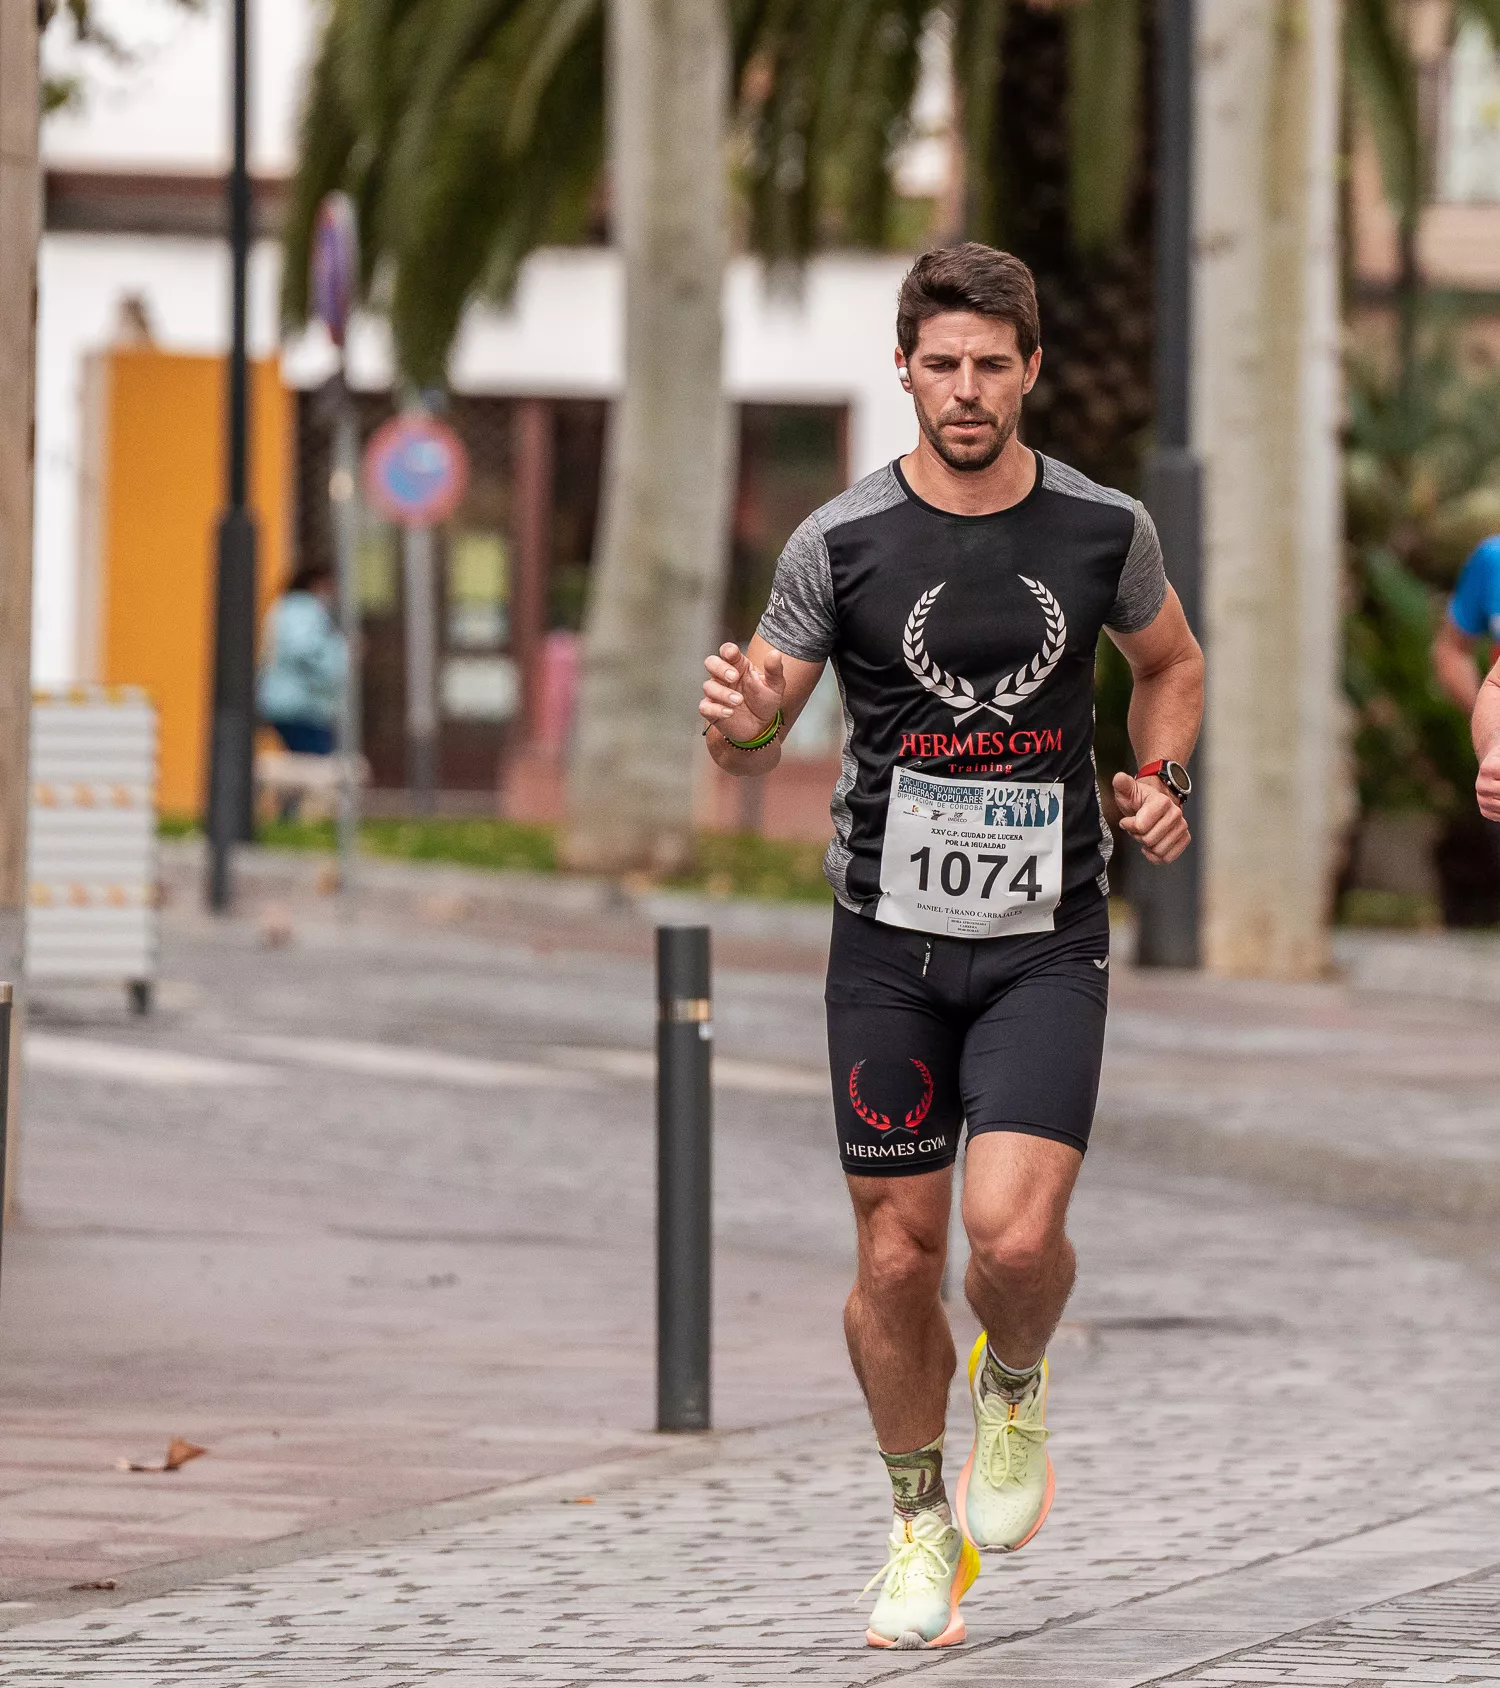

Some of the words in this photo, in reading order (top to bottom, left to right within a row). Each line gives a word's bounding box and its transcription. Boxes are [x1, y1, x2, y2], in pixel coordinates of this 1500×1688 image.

[898, 732, 1004, 756] HERMES
[1009, 728, 1062, 755] GYM
[948, 762, 1012, 774] Training
[898, 784, 935, 800] CARRERAS
[937, 793, 983, 804] POPULARES
[900, 776, 927, 790] CIRCUITO
[929, 784, 972, 795] PROVINCIAL
[974, 788, 984, 796] DE
[985, 787, 1028, 806] 2024
[931, 828, 946, 836] XXV
[947, 830, 960, 838] C.P.
[997, 833, 1024, 841] LUCENA
[945, 839, 959, 847] POR
[960, 840, 970, 848] LA
[971, 841, 1006, 850] IGUALDAD
[910, 846, 1042, 901] 1074
[916, 902, 944, 913] DANIEL
[944, 907, 976, 917] TÁRANO
[976, 909, 1022, 919] CARBAJALES
[846, 1142, 916, 1158] HERMES
[918, 1134, 946, 1152] GYM
